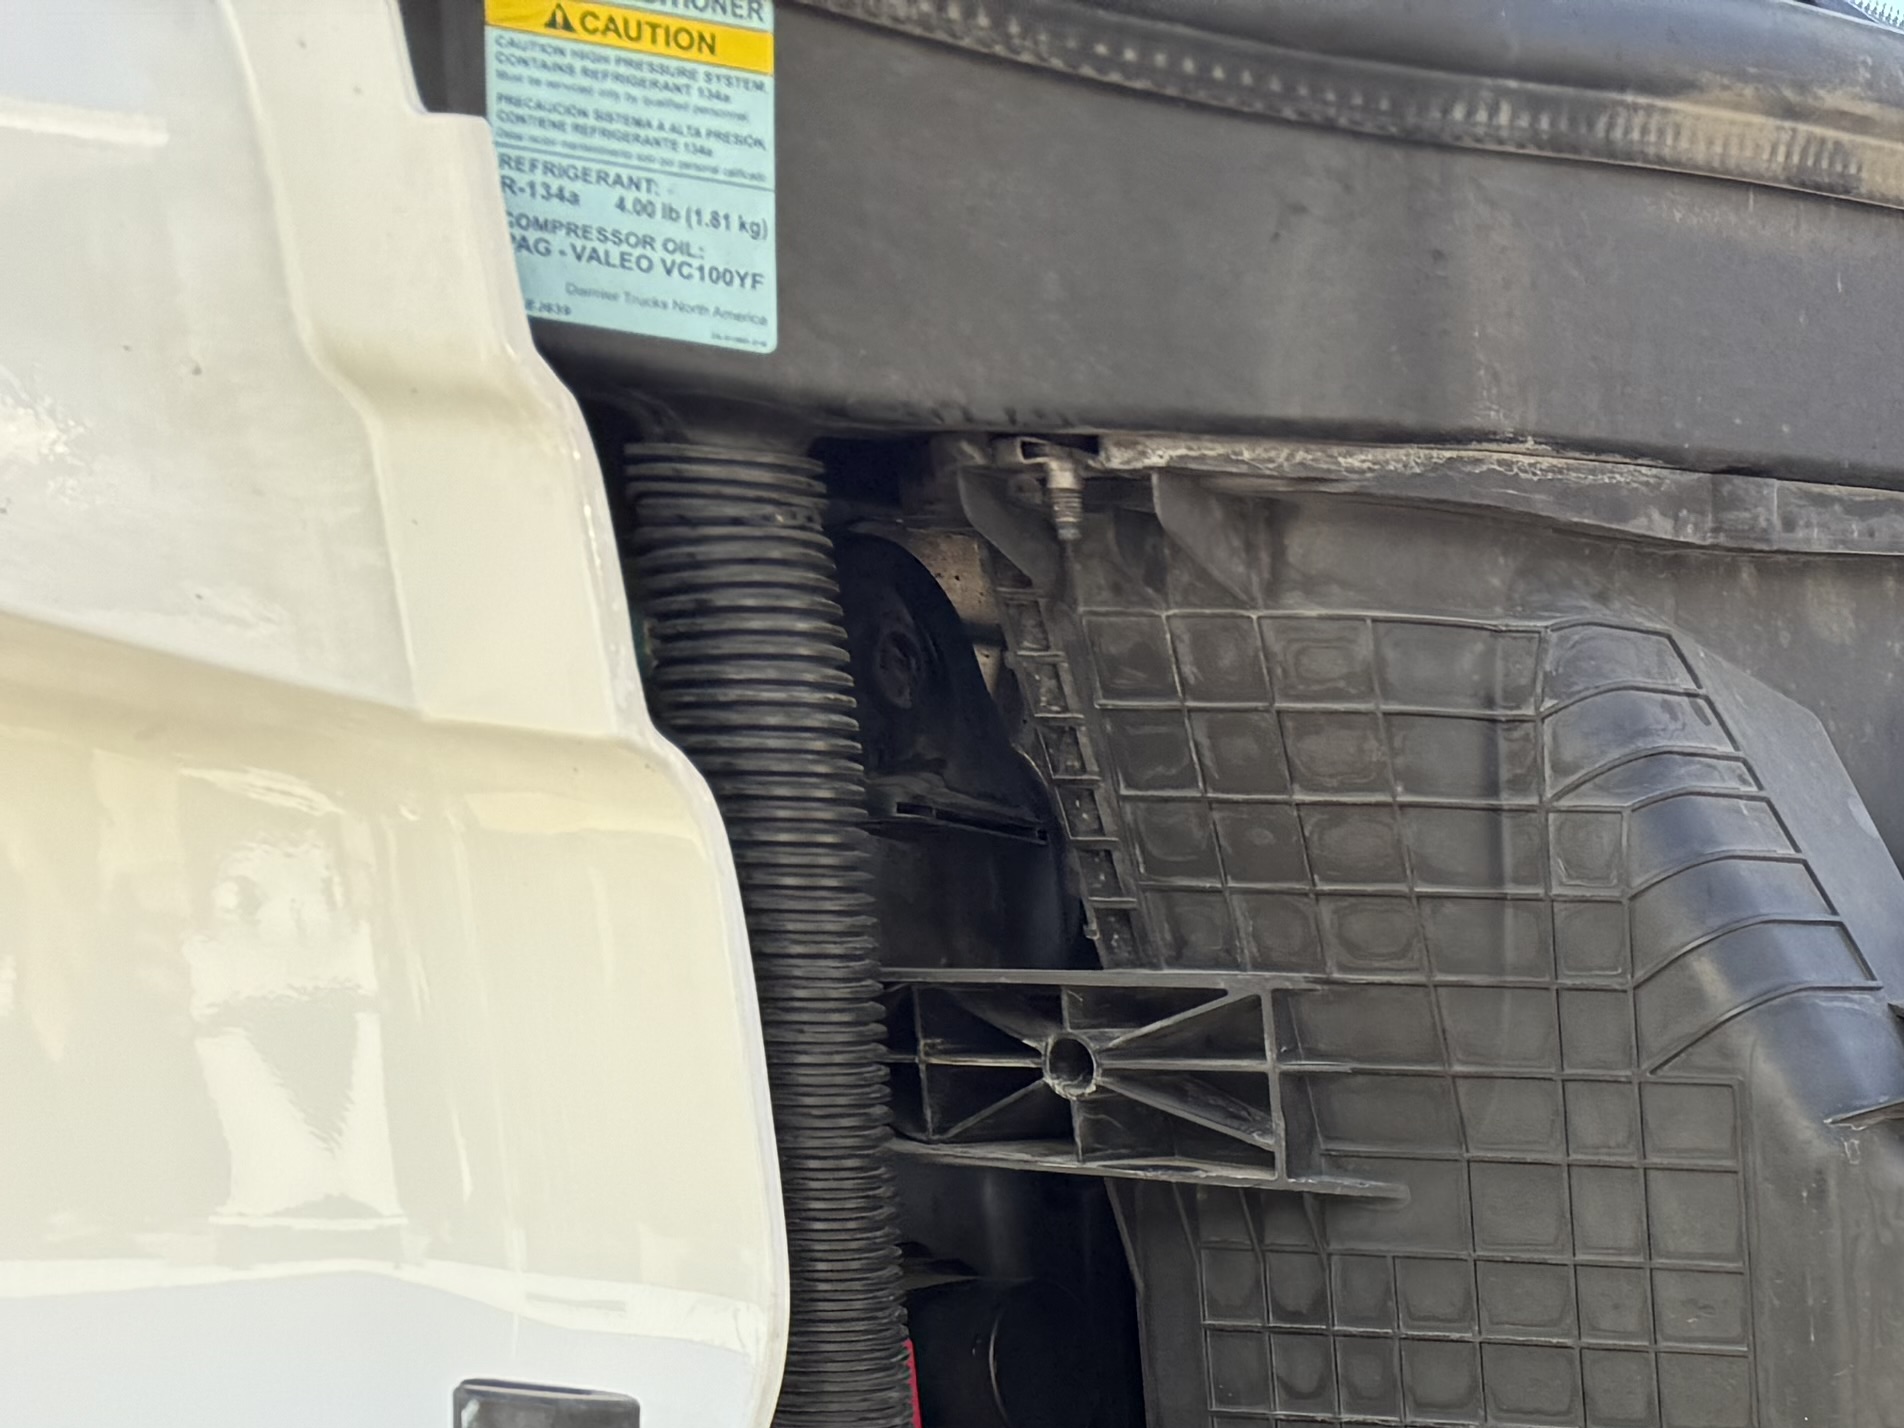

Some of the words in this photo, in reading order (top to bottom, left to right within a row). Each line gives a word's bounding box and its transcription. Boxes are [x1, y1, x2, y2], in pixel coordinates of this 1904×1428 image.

[579, 10, 717, 56] CAUTION
[501, 175, 581, 206] R-134a
[615, 195, 656, 219] 4.00
[661, 202, 681, 223] lb
[738, 214, 769, 241] kg)
[569, 242, 655, 274] VALEO
[660, 257, 766, 291] VC100YF
